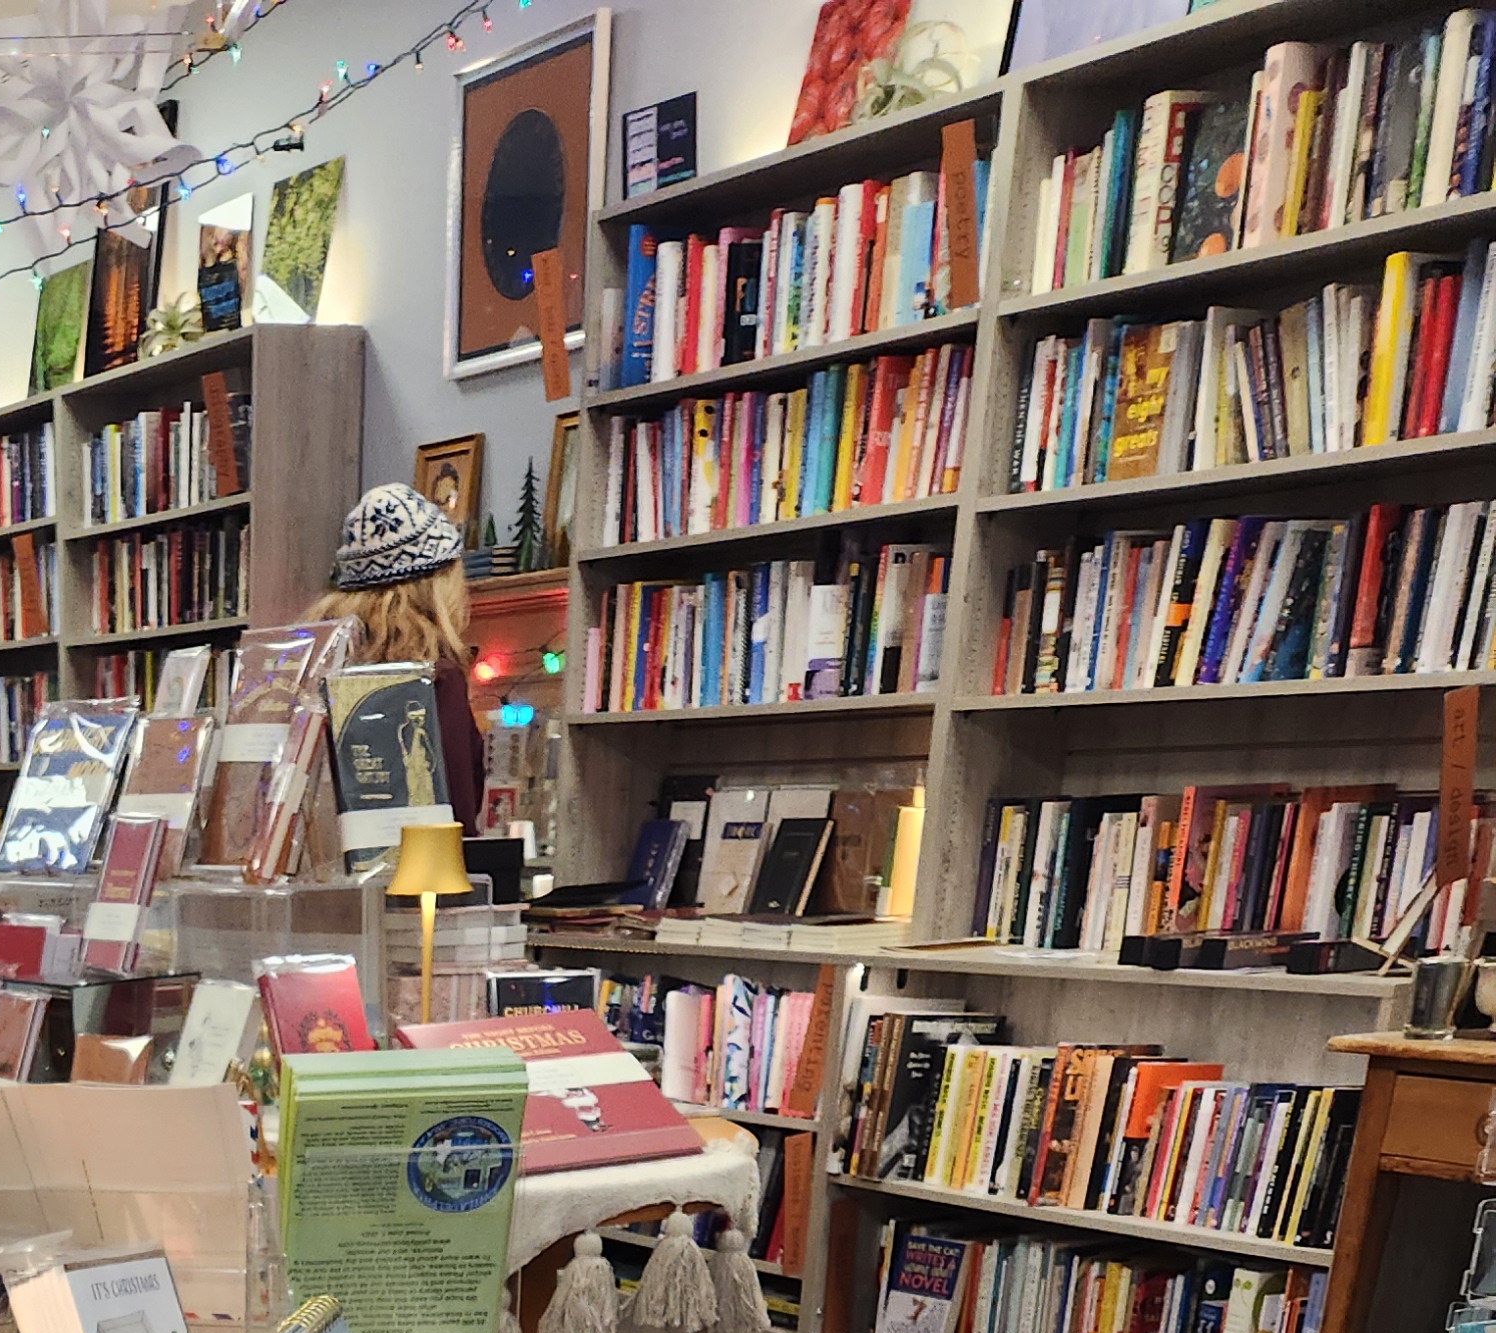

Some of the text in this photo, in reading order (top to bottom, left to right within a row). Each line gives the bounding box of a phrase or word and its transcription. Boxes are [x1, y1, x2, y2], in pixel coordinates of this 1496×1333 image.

[953, 172, 972, 259] poetry
[1445, 708, 1467, 868] art design
[800, 983, 834, 1091] parenting
[92, 1273, 161, 1301] IT'S CHRISTMAS
[898, 1272, 949, 1295] NOVEL
